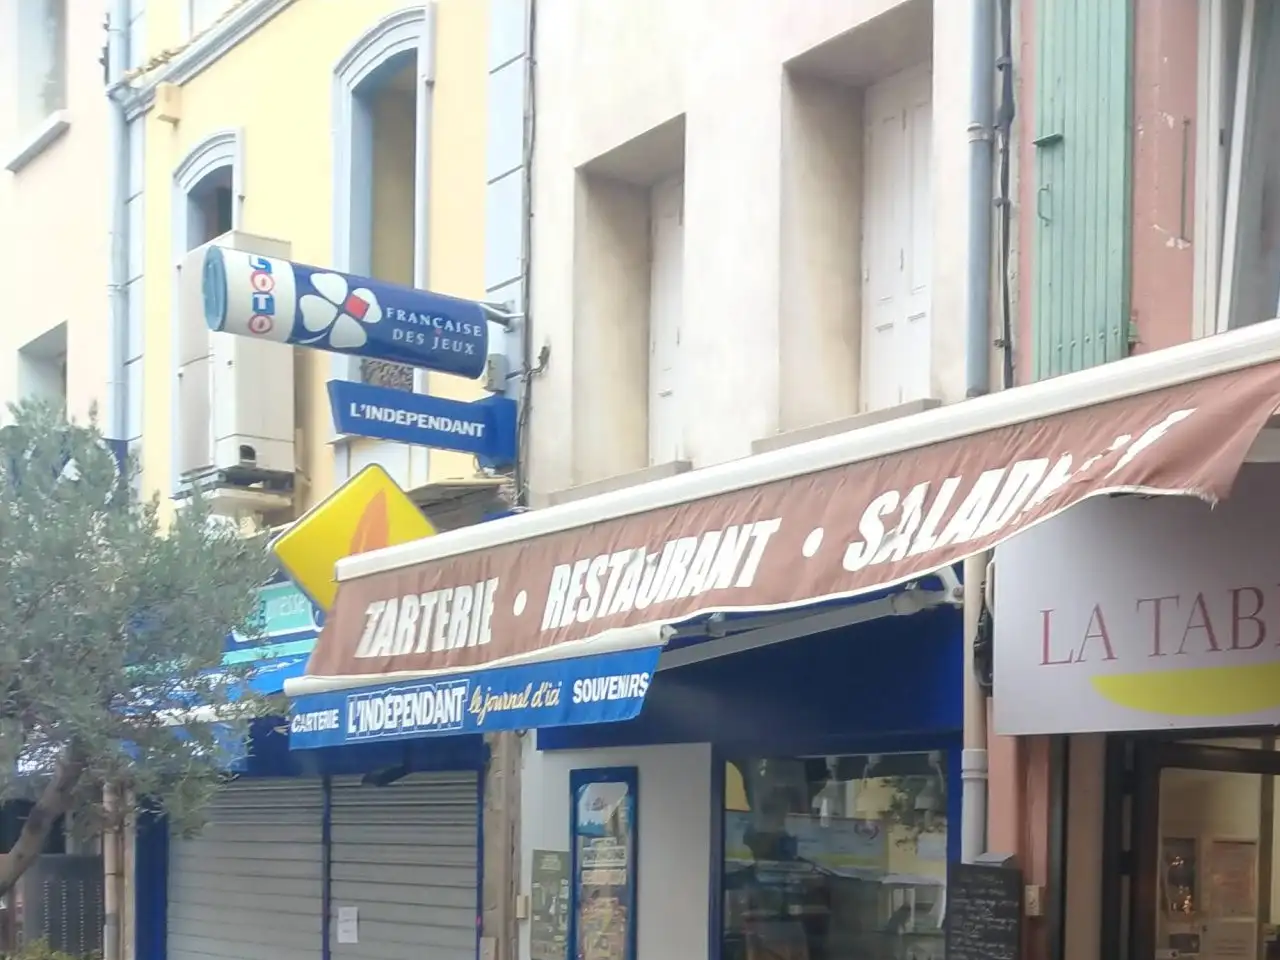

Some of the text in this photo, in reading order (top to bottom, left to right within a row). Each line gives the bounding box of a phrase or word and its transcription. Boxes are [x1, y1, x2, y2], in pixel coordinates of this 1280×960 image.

[386, 307, 483, 337] FRANÇAISE
[392, 328, 476, 355] DES JEUX
[350, 402, 486, 438] L'INDÉPENDANT
[354, 577, 499, 658] TARTERIE
[540, 518, 782, 632] RESTAURANT
[1039, 604, 1118, 666] LA
[291, 708, 340, 733] CARTERIE
[347, 686, 467, 735] L'INDÉPENDANT
[572, 672, 650, 704] SOUVENIRS
